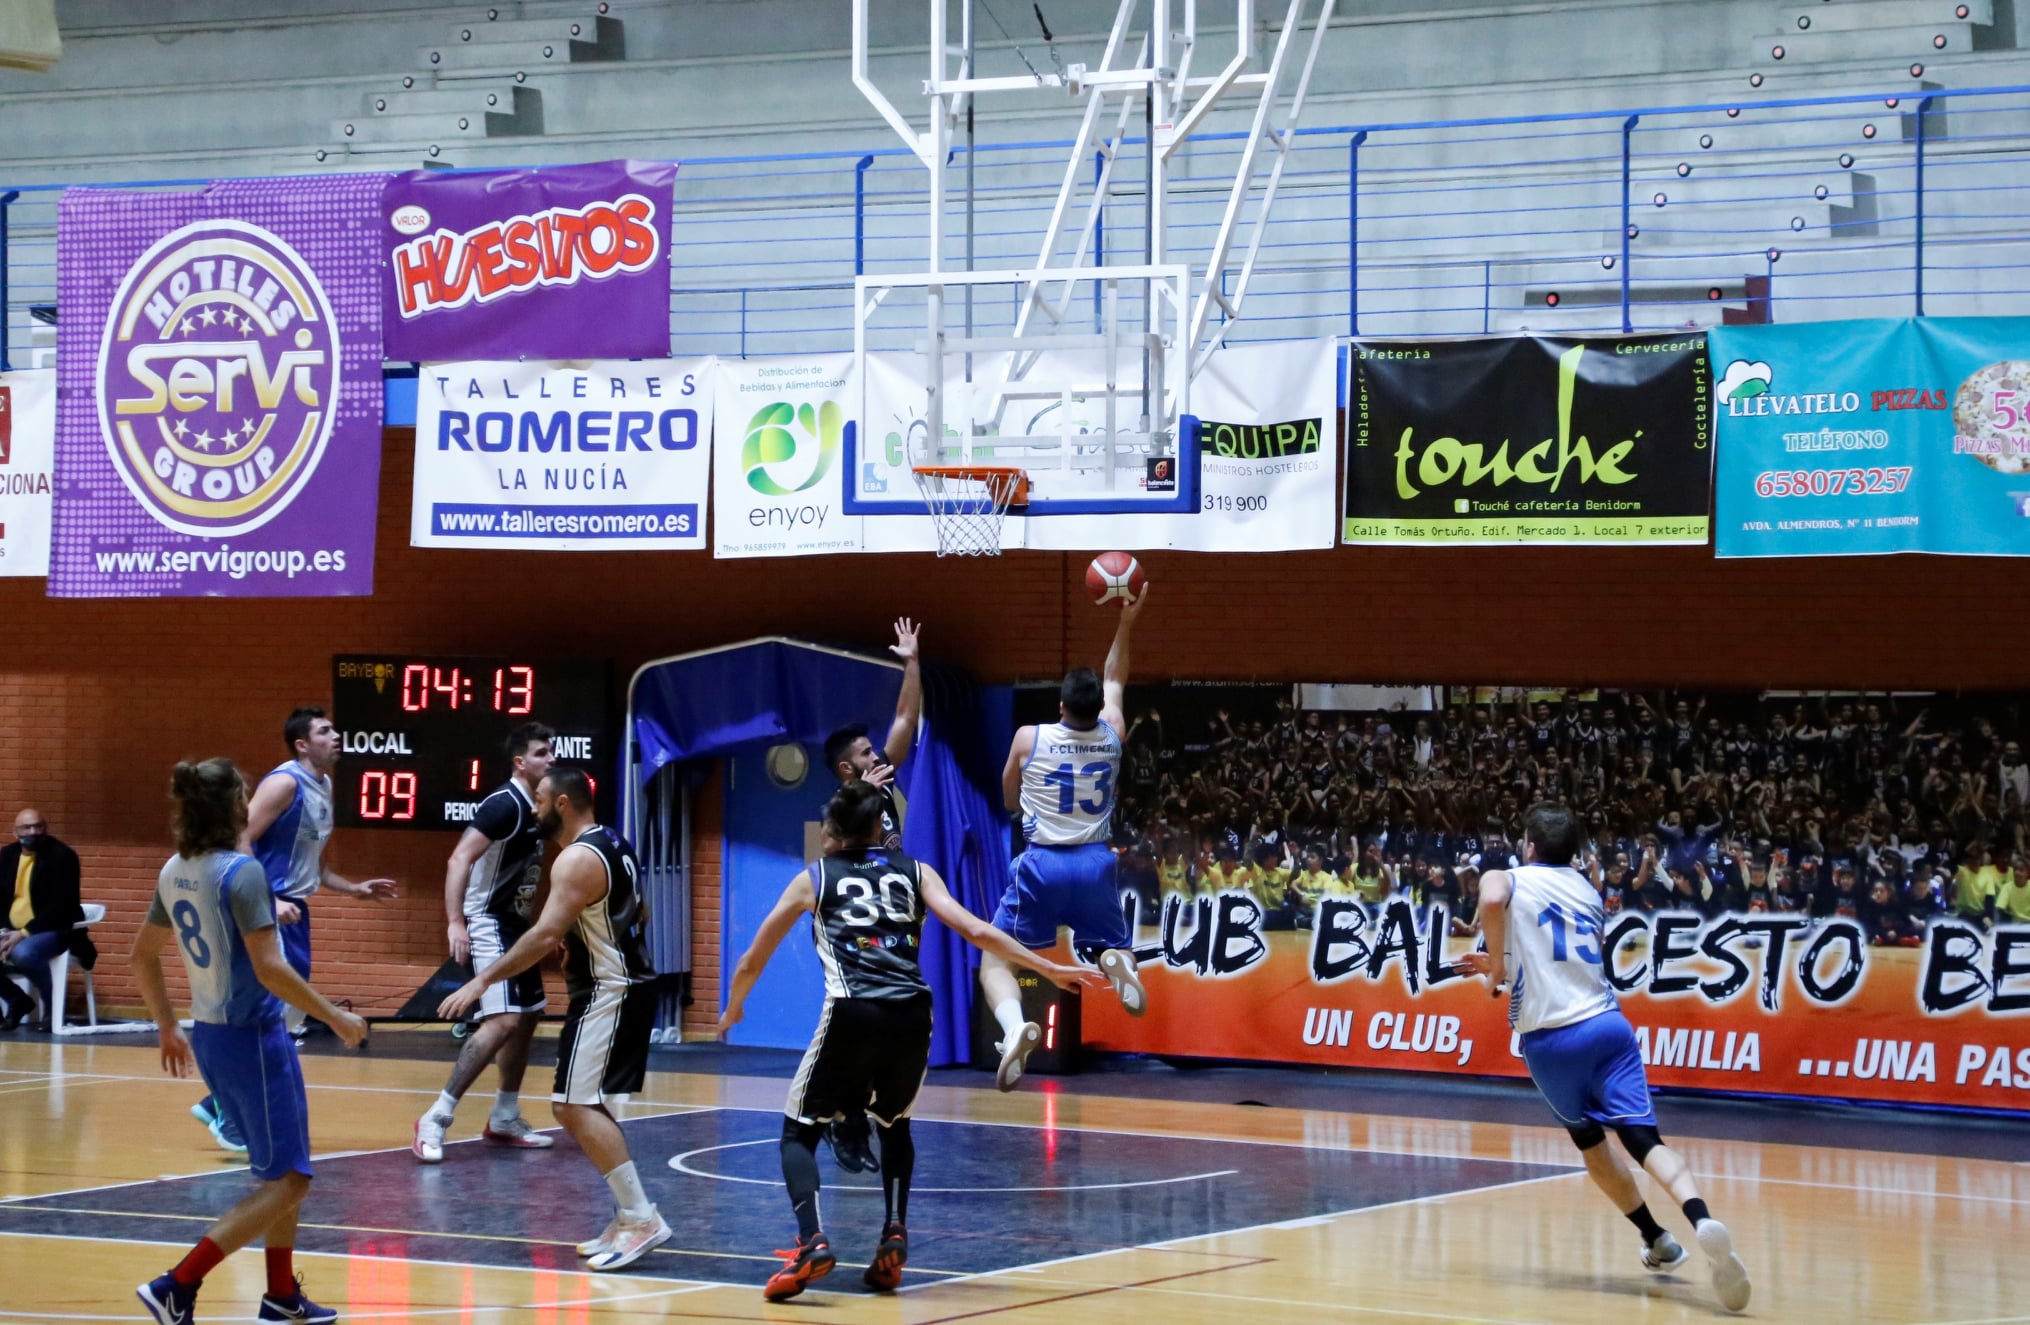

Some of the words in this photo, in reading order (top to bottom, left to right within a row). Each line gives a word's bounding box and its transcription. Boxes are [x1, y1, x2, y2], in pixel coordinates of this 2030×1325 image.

[395, 214, 425, 226] VALOR
[396, 198, 656, 314] HUESITOS
[144, 260, 297, 330] HOTELES
[1616, 339, 1704, 354] Cervecería
[115, 328, 325, 414] Servi
[811, 366, 822, 374] de
[437, 374, 696, 399] TALLERES
[739, 383, 775, 392] Bebidas
[1694, 357, 1706, 449] Coctelería
[1729, 392, 1860, 417] LLÉVATELO
[1872, 389, 1948, 411] PIZZAS
[437, 408, 698, 453] ROMERO
[1394, 344, 1644, 500] touché
[1784, 429, 1888, 452] TELÉFONO
[154, 445, 275, 499] GROUP
[498, 467, 527, 490] LA
[544, 462, 628, 490] NUCÍA
[1256, 460, 1320, 476] HOSTELEROS
[1756, 467, 1912, 497] 658073257
[0, 472, 53, 495] CIONA
[864, 482, 882, 491] EBA
[1204, 494, 1233, 511] 319
[1236, 495, 1268, 512] 900
[1472, 501, 1510, 511] Touché
[1515, 500, 1579, 511] cafetería
[1585, 500, 1641, 510] Benidorm
[440, 510, 690, 533] www.talleresromero.es
[749, 505, 829, 531] enyoy
[1353, 525, 1387, 536] Calle
[1394, 526, 1425, 536] Tomás
[1516, 525, 1566, 536] Mercado
[1594, 525, 1628, 536] Local
[1635, 525, 1643, 535] 7
[1650, 524, 1705, 535] exterior
[96, 543, 346, 579] www.servigroup.es
[402, 663, 534, 714] 04:13
[342, 731, 413, 755] LOCAL
[1050, 743, 1114, 755] F.CLIMENT
[470, 759, 479, 790] 1
[1044, 761, 1114, 815] 13
[360, 771, 417, 820] 09
[444, 802, 481, 821] PERIO
[174, 876, 199, 893] PABLO
[836, 872, 916, 927] 30
[172, 899, 211, 968] 8
[1077, 891, 1266, 977] LUB
[1537, 902, 1603, 965] 15
[1046, 1003, 1057, 1049] 1
[1302, 1007, 1353, 1047] UN
[1367, 1011, 1473, 1066] CLUB,
[1636, 1026, 1762, 1072] AMILIA
